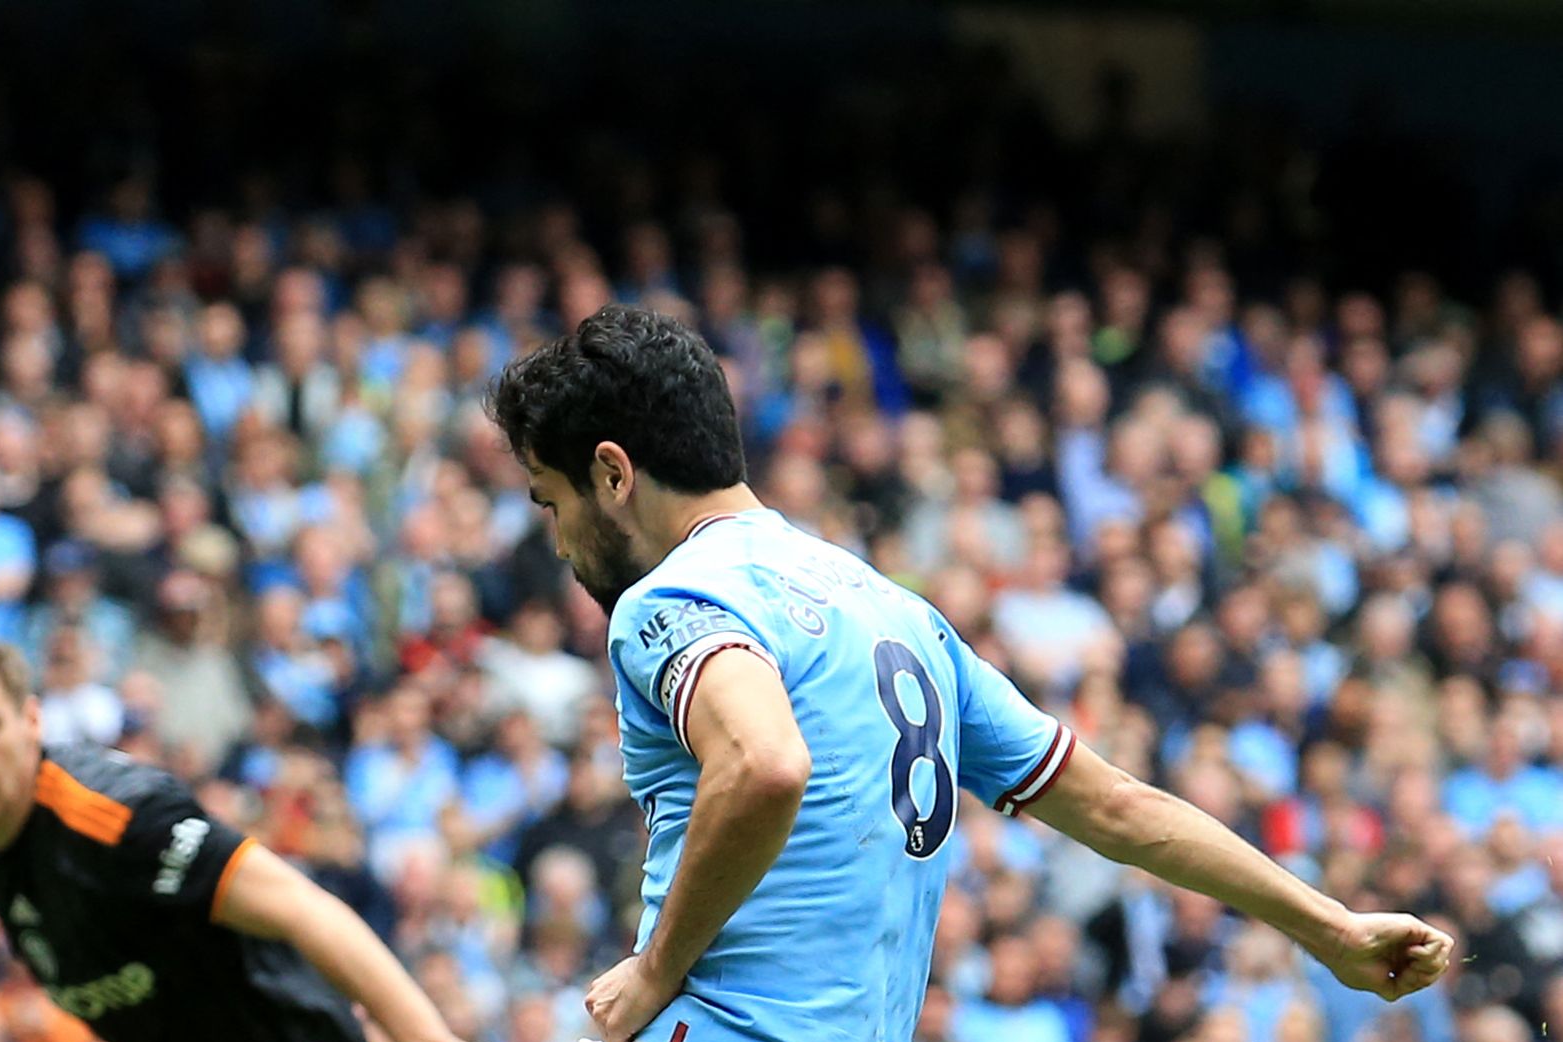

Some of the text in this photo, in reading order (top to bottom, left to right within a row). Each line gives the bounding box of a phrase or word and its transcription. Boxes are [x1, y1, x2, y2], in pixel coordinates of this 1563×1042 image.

[638, 600, 727, 650] NEXE
[660, 614, 732, 653] TIRE
[873, 639, 957, 861] 8
